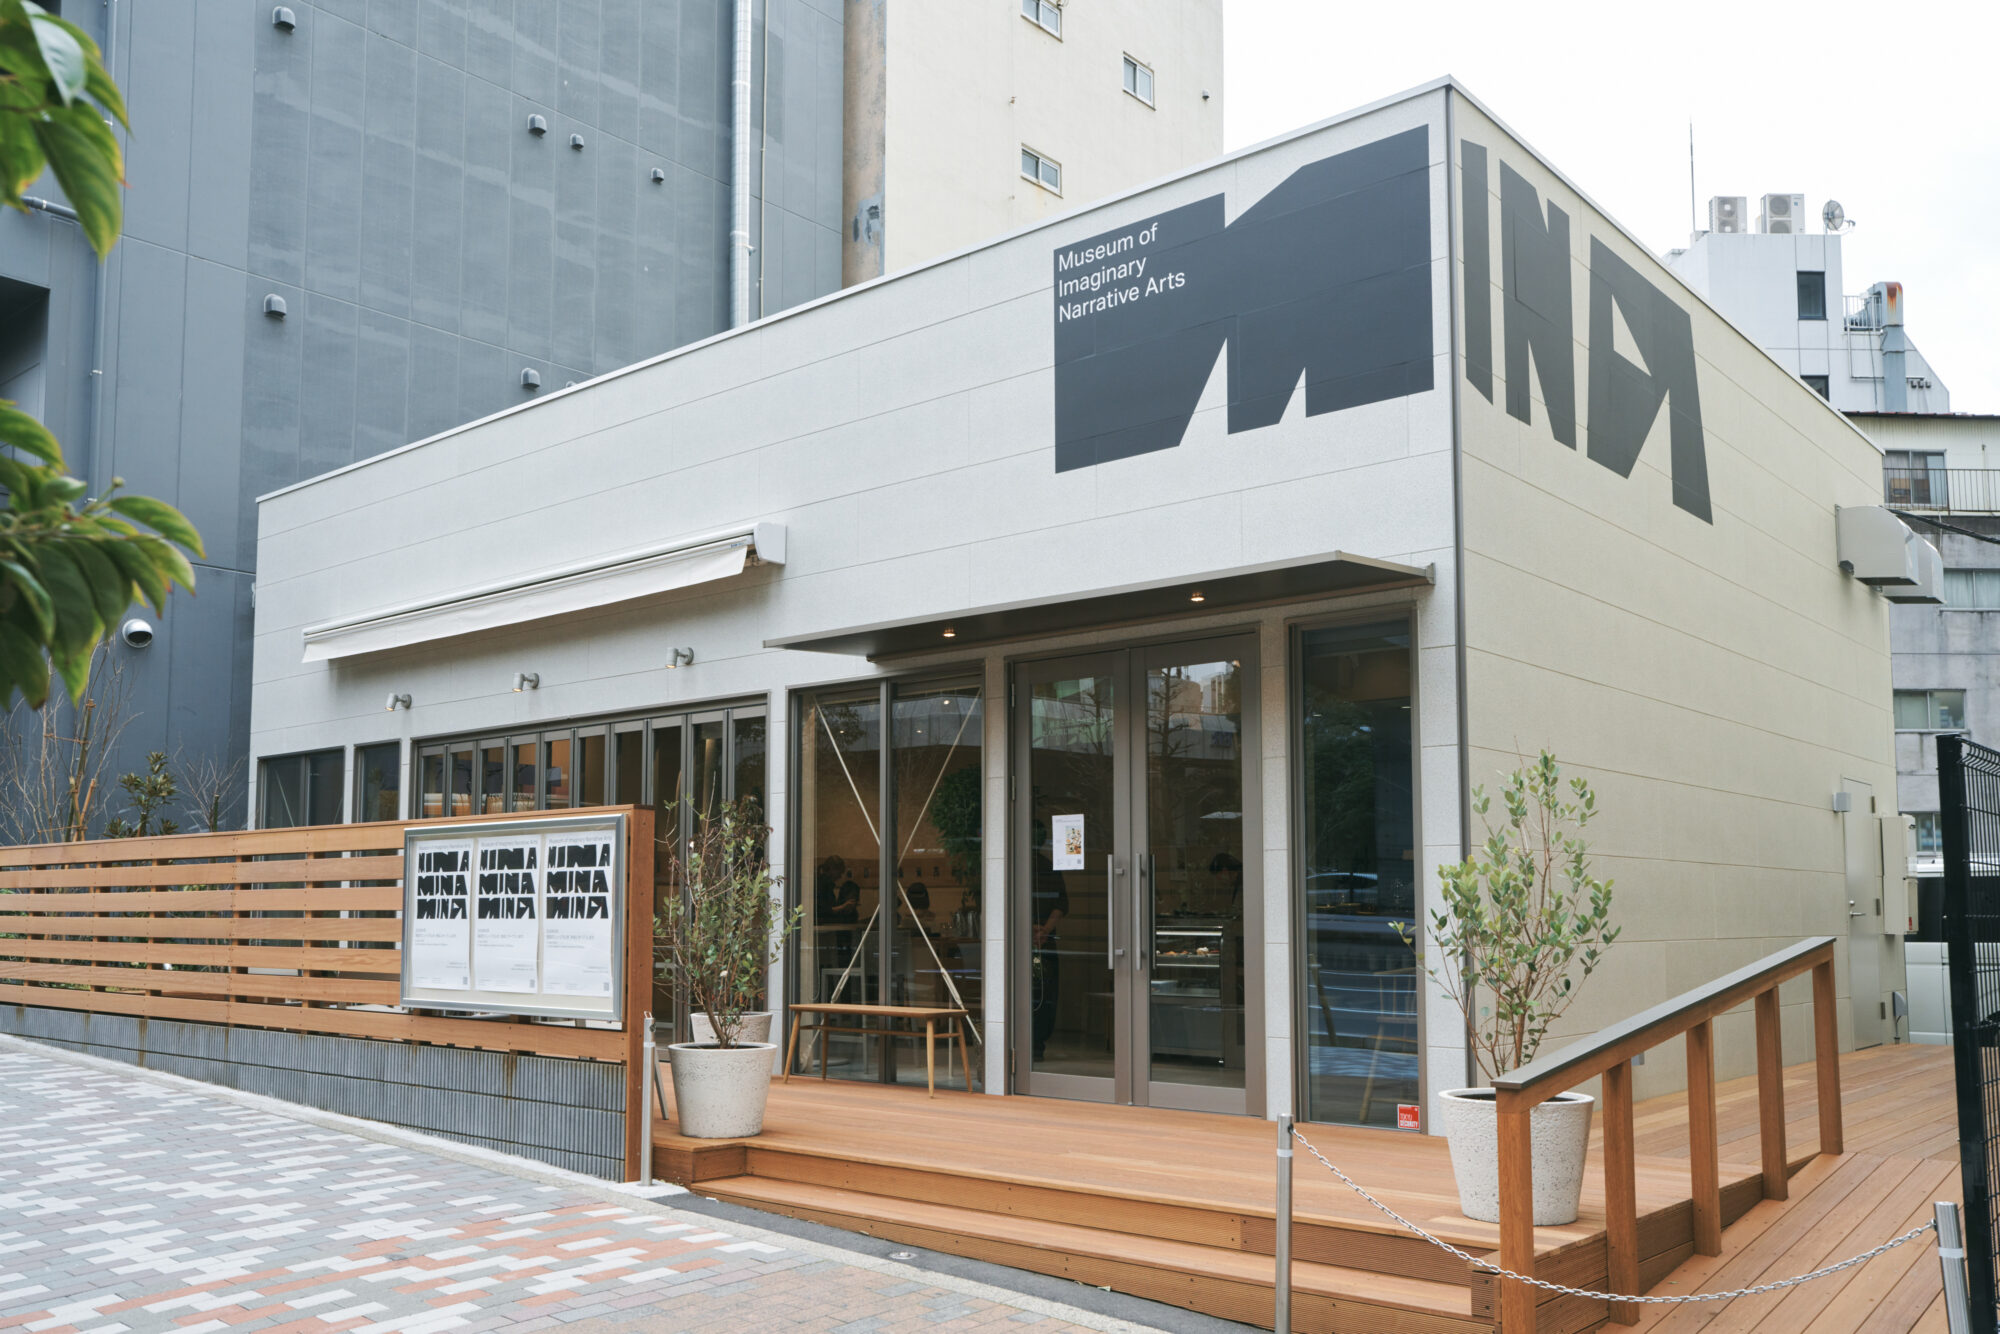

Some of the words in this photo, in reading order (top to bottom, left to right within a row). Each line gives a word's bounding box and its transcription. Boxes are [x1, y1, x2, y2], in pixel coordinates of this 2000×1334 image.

[1058, 235, 1134, 272] Museum
[1138, 222, 1159, 245] of
[1058, 257, 1147, 298] Imaginary
[1058, 286, 1140, 323] Narrative
[1145, 272, 1186, 297] Arts
[417, 874, 468, 896] MINA
[479, 872, 536, 895] MINA
[546, 869, 609, 894] MINA
[416, 898, 468, 920] MINA
[478, 896, 536, 920] MINA
[546, 895, 609, 919] MINA
